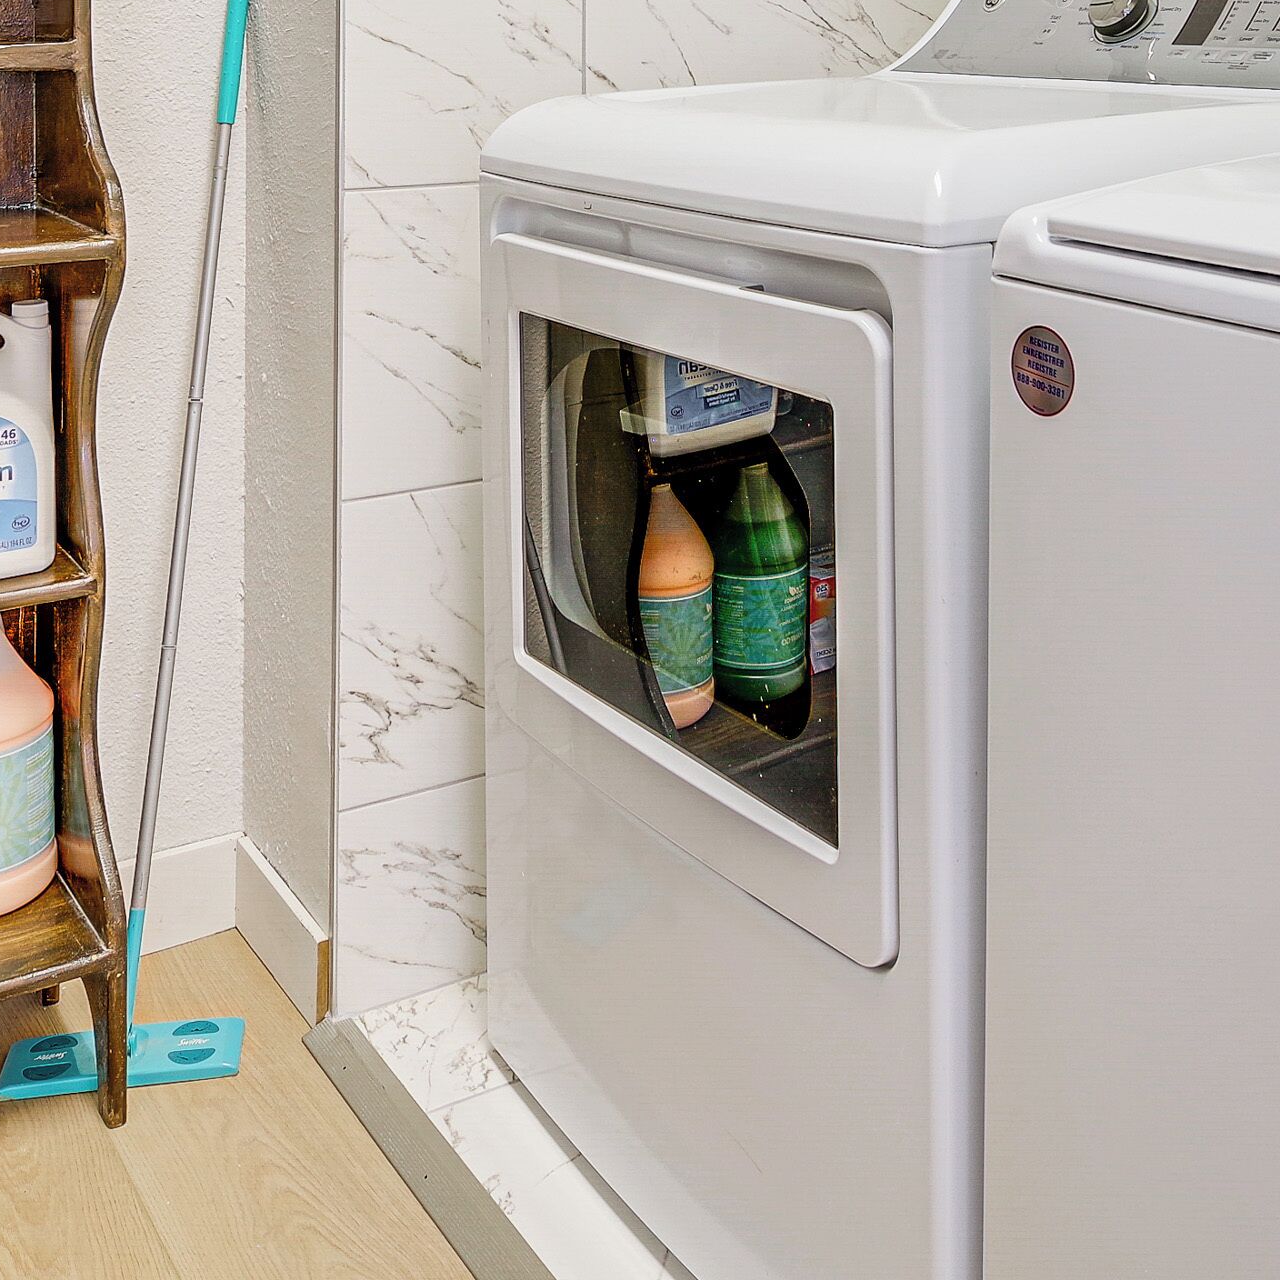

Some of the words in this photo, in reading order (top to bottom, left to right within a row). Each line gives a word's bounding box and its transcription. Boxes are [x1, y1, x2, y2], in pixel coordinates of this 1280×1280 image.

[1029, 336, 1060, 354] REGISTER
[1022, 346, 1065, 368] ENREGISTRER
[177, 1036, 210, 1047] Swiffer
[34, 1051, 68, 1061] Swiffer
